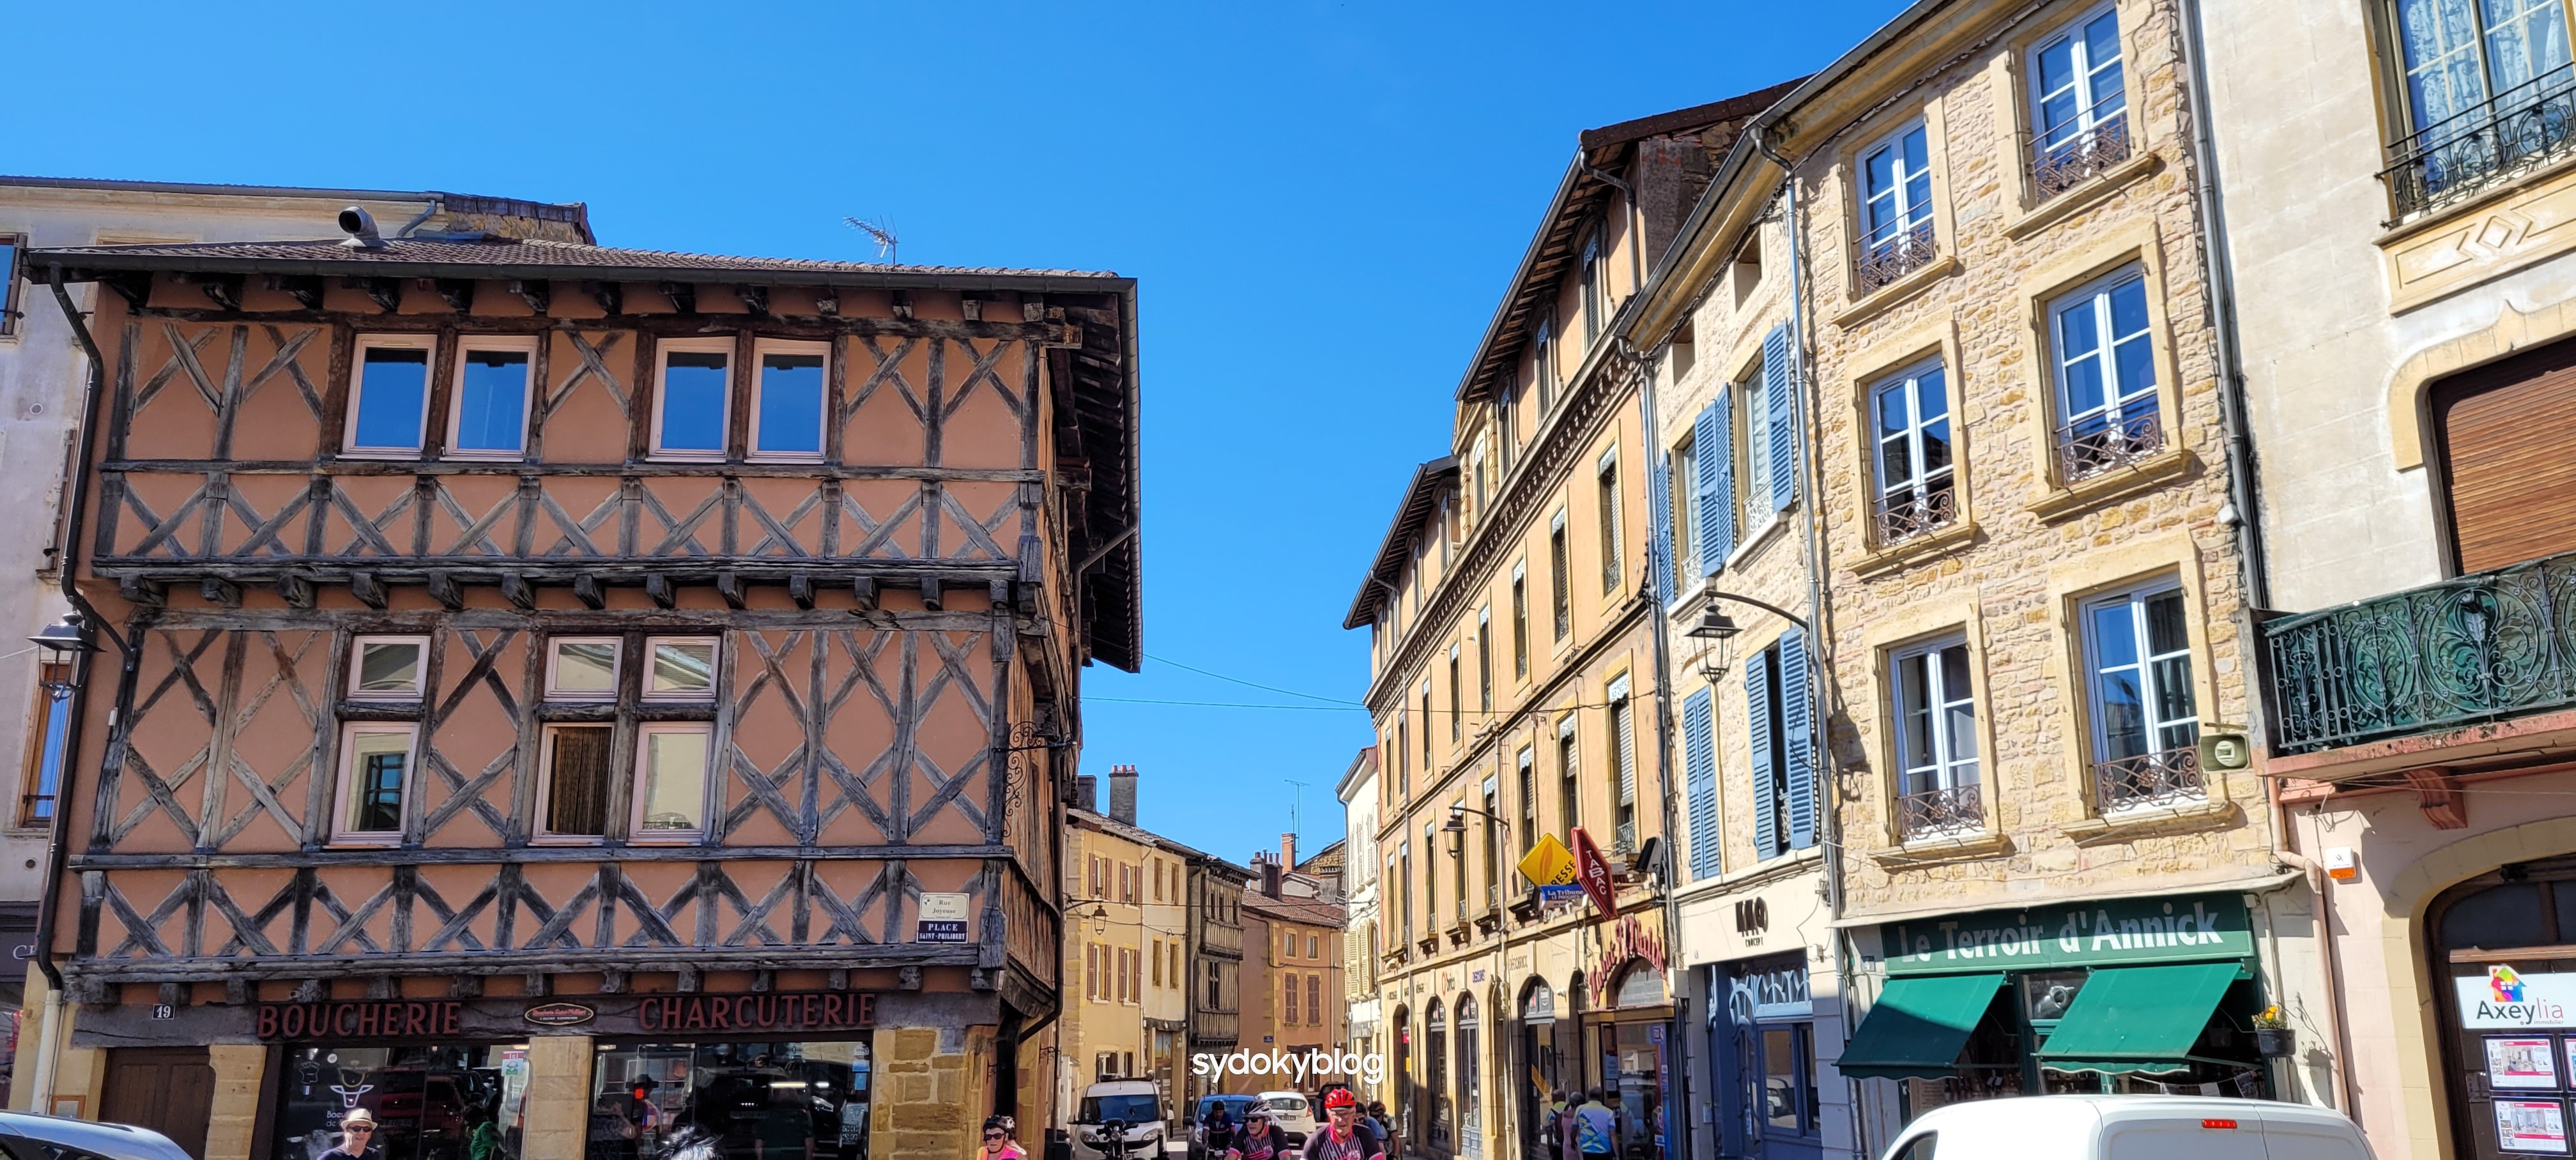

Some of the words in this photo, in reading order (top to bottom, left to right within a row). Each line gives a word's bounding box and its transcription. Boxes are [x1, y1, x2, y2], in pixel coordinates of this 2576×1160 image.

[1550, 859, 1576, 885] RESSE
[1586, 850, 1607, 895] TABAC
[1898, 926, 1931, 963] Le
[1939, 914, 2043, 959] Terroir
[2058, 901, 2224, 953] d'Annick
[157, 1005, 171, 1018] 19
[257, 1002, 462, 1038] BOUCHERIE
[640, 993, 876, 1030] CHARCUTERIE
[2476, 998, 2564, 1025] Axeylia
